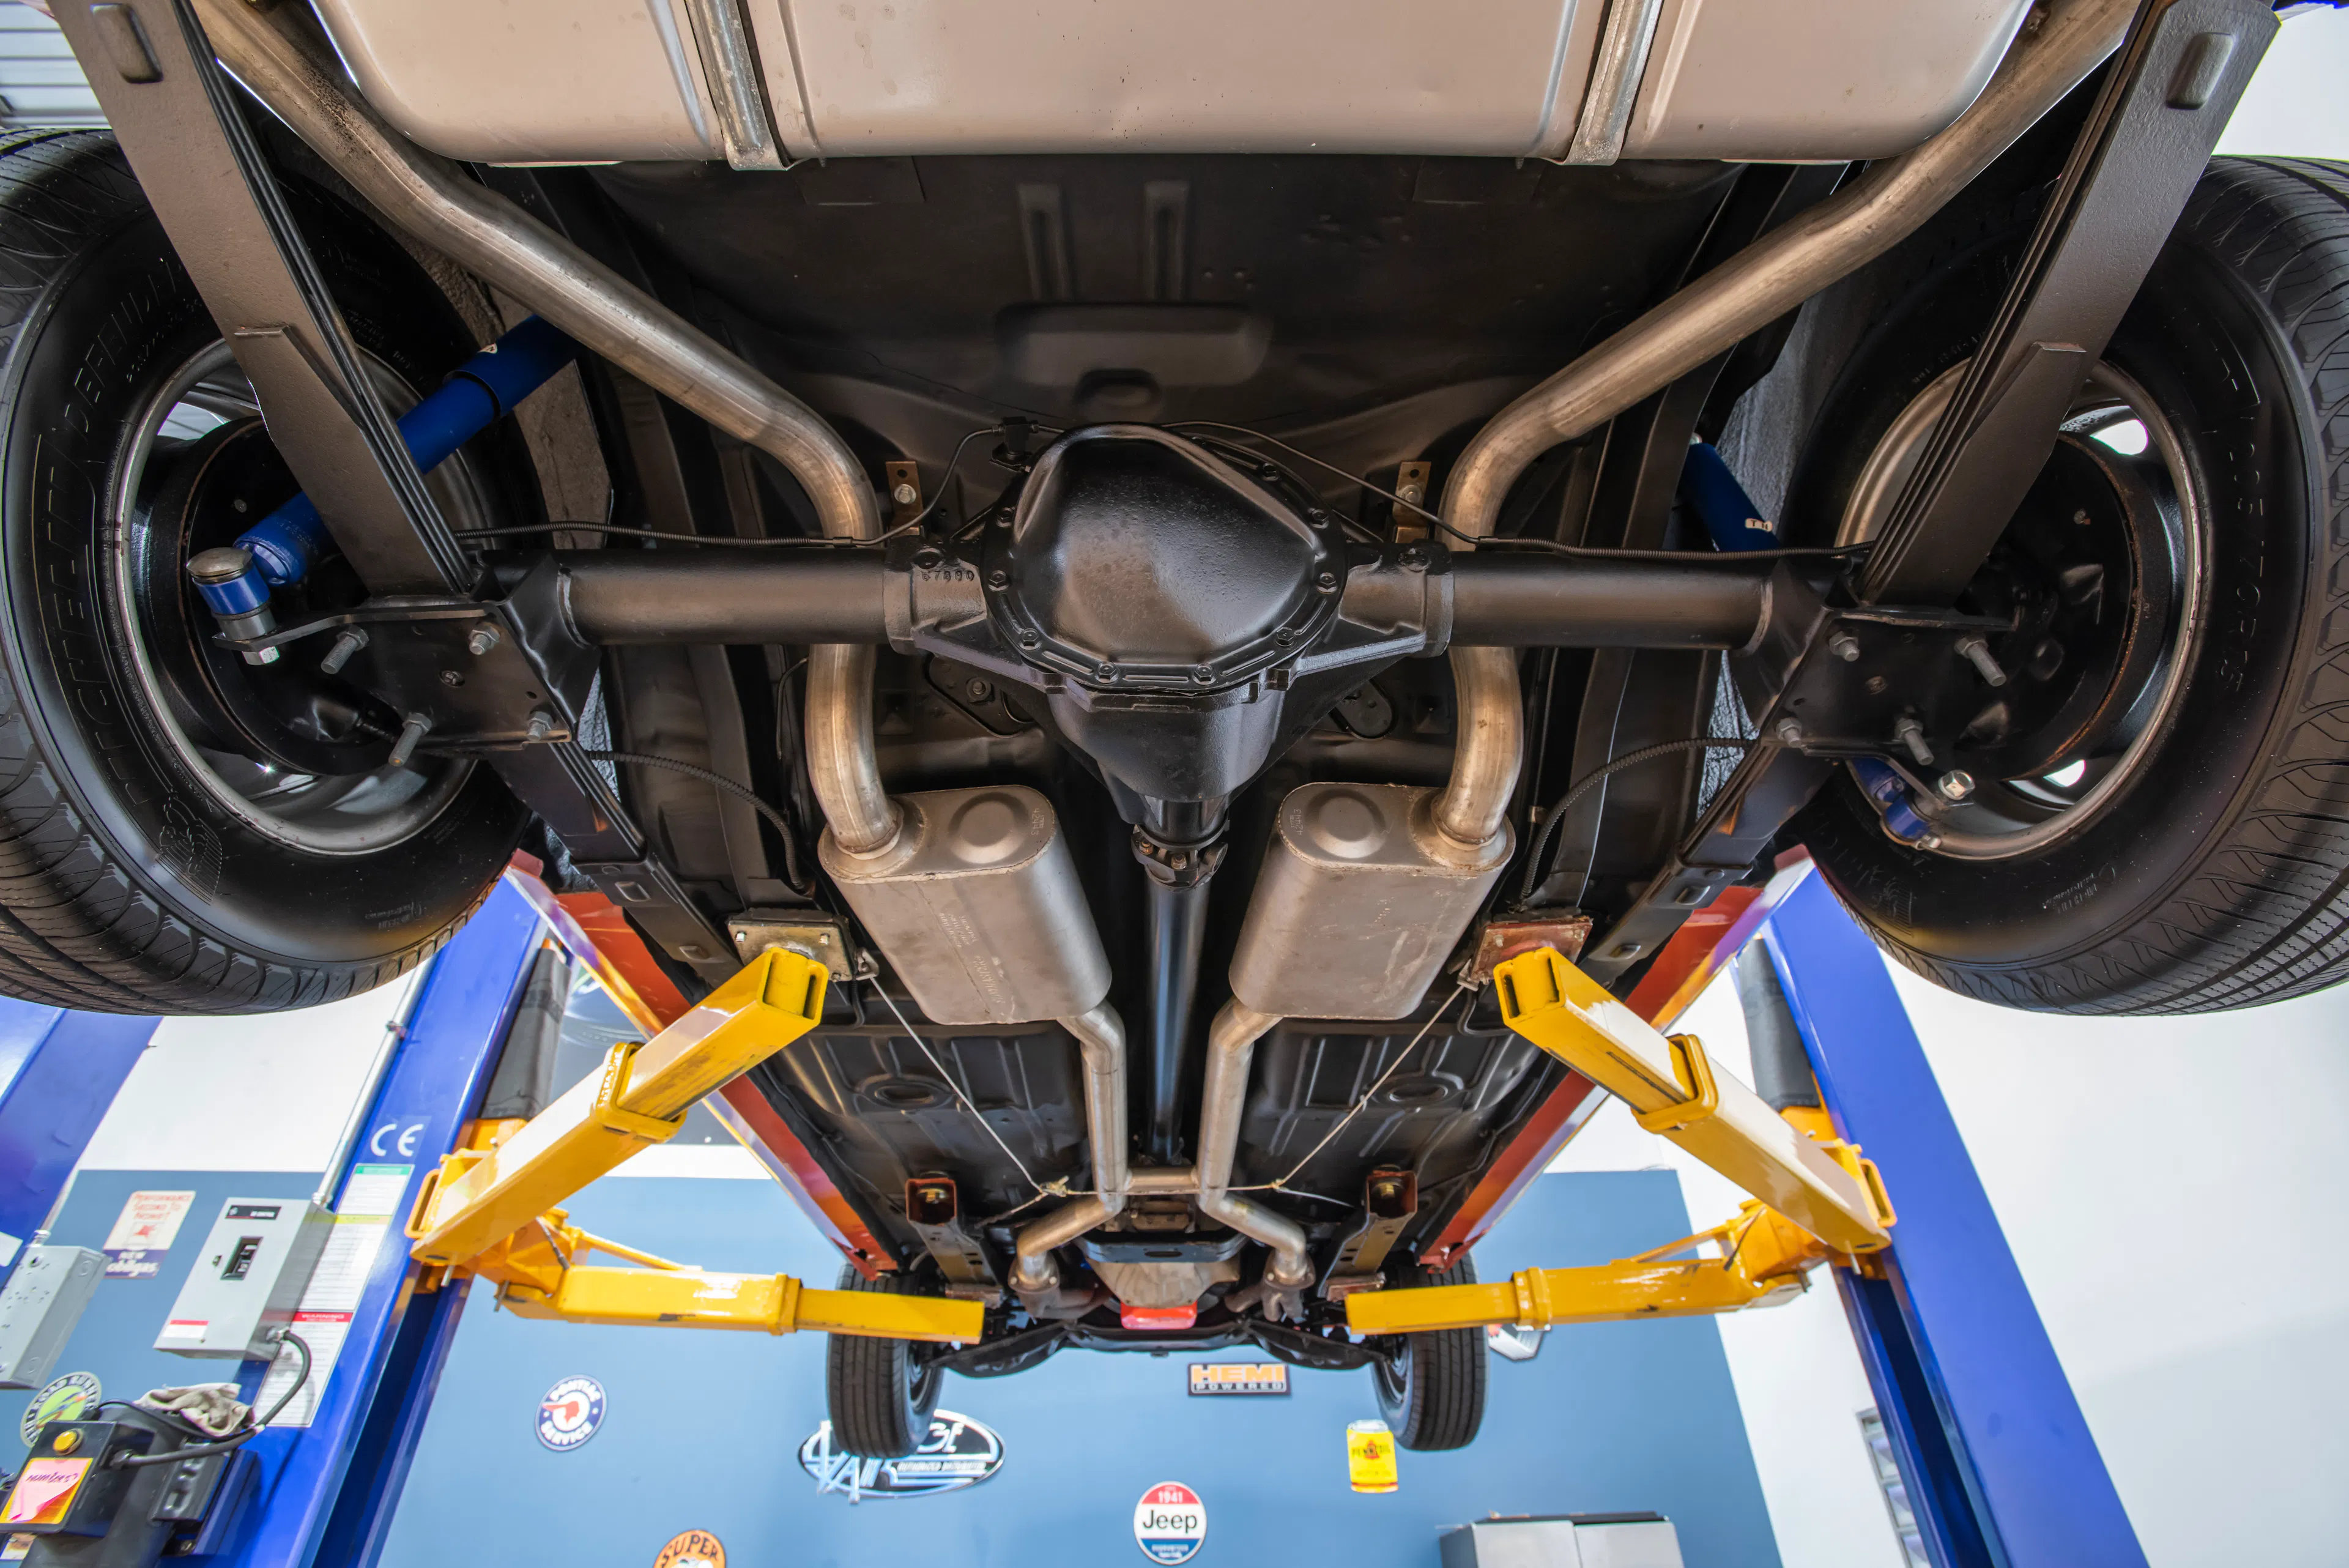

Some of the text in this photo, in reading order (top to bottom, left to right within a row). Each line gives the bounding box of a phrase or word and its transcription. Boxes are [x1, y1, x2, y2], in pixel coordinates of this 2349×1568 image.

[1192, 1364, 1284, 1383] HEMI
[549, 1378, 601, 1403] PONTIAC
[1159, 1491, 1183, 1503] 1941
[1143, 1509, 1197, 1534] Jeep
